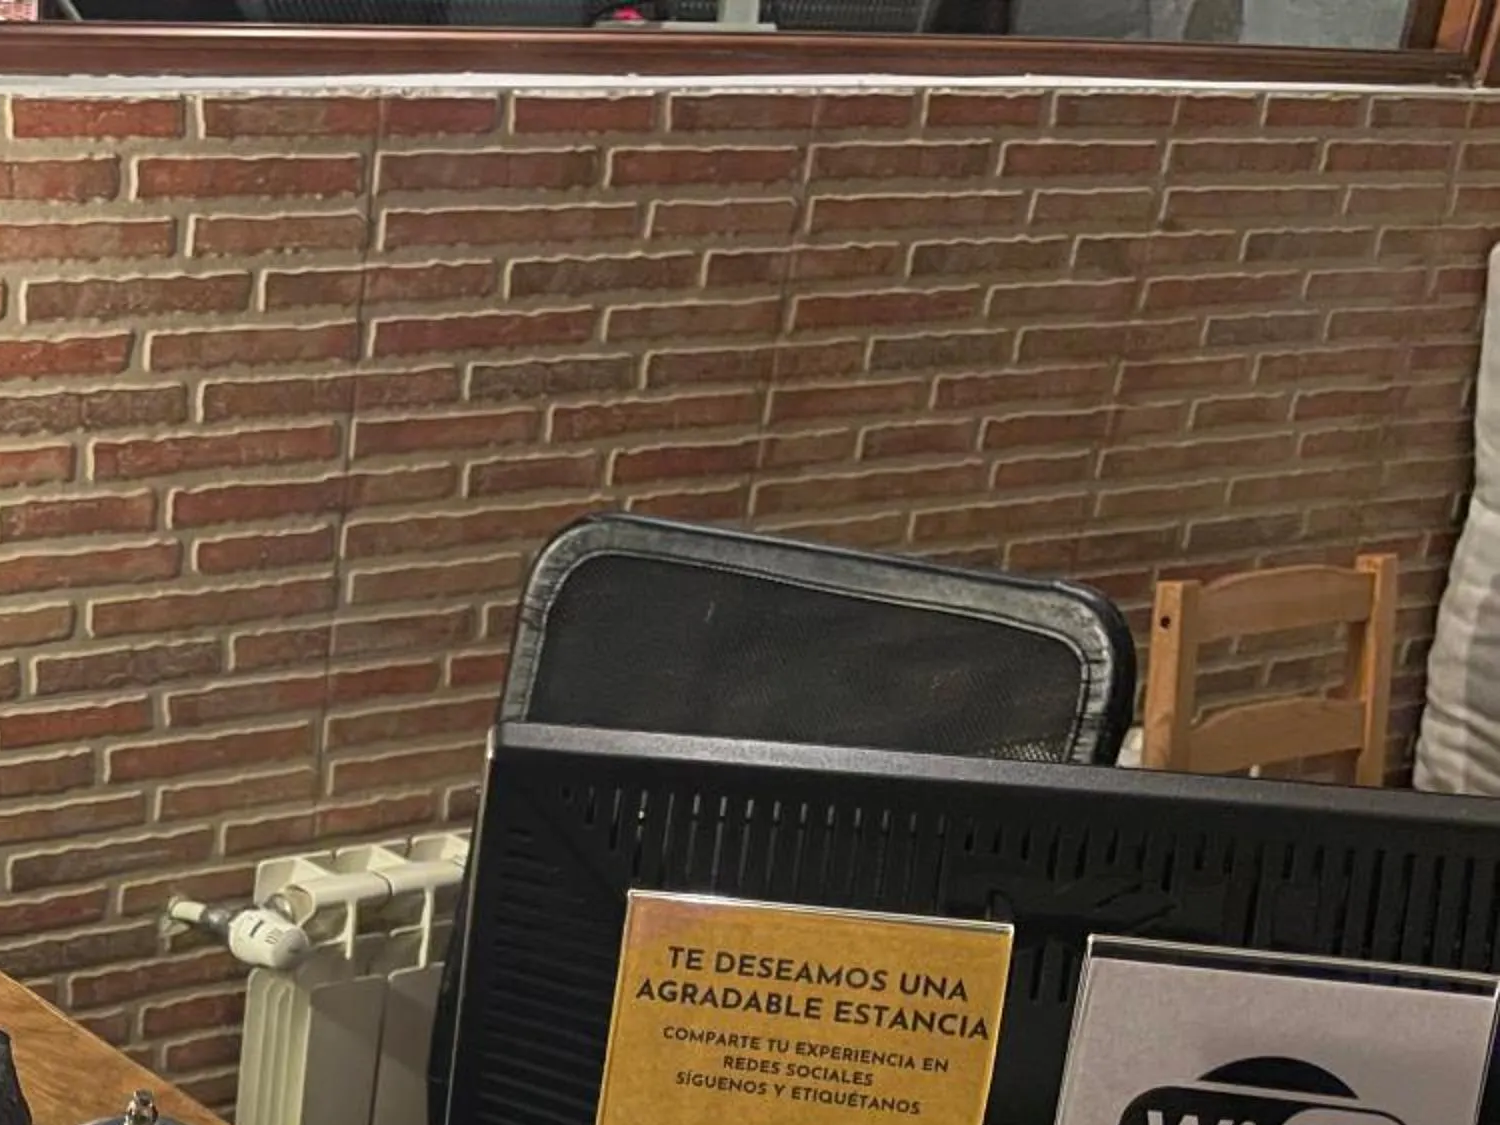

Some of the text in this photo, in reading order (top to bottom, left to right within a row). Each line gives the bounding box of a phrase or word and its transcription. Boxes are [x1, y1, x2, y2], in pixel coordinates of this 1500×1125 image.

[668, 946, 968, 1002] TE DESEAMOS UNA
[636, 978, 989, 1040] AGRADABLE ESTANCIA
[663, 1026, 949, 1072] COMPARTE TU EXPERIENCIA EN
[723, 1055, 874, 1086] REDES SOCIALES
[676, 1069, 921, 1114] SÍGUENOS Y ETIQUÉTANOS
